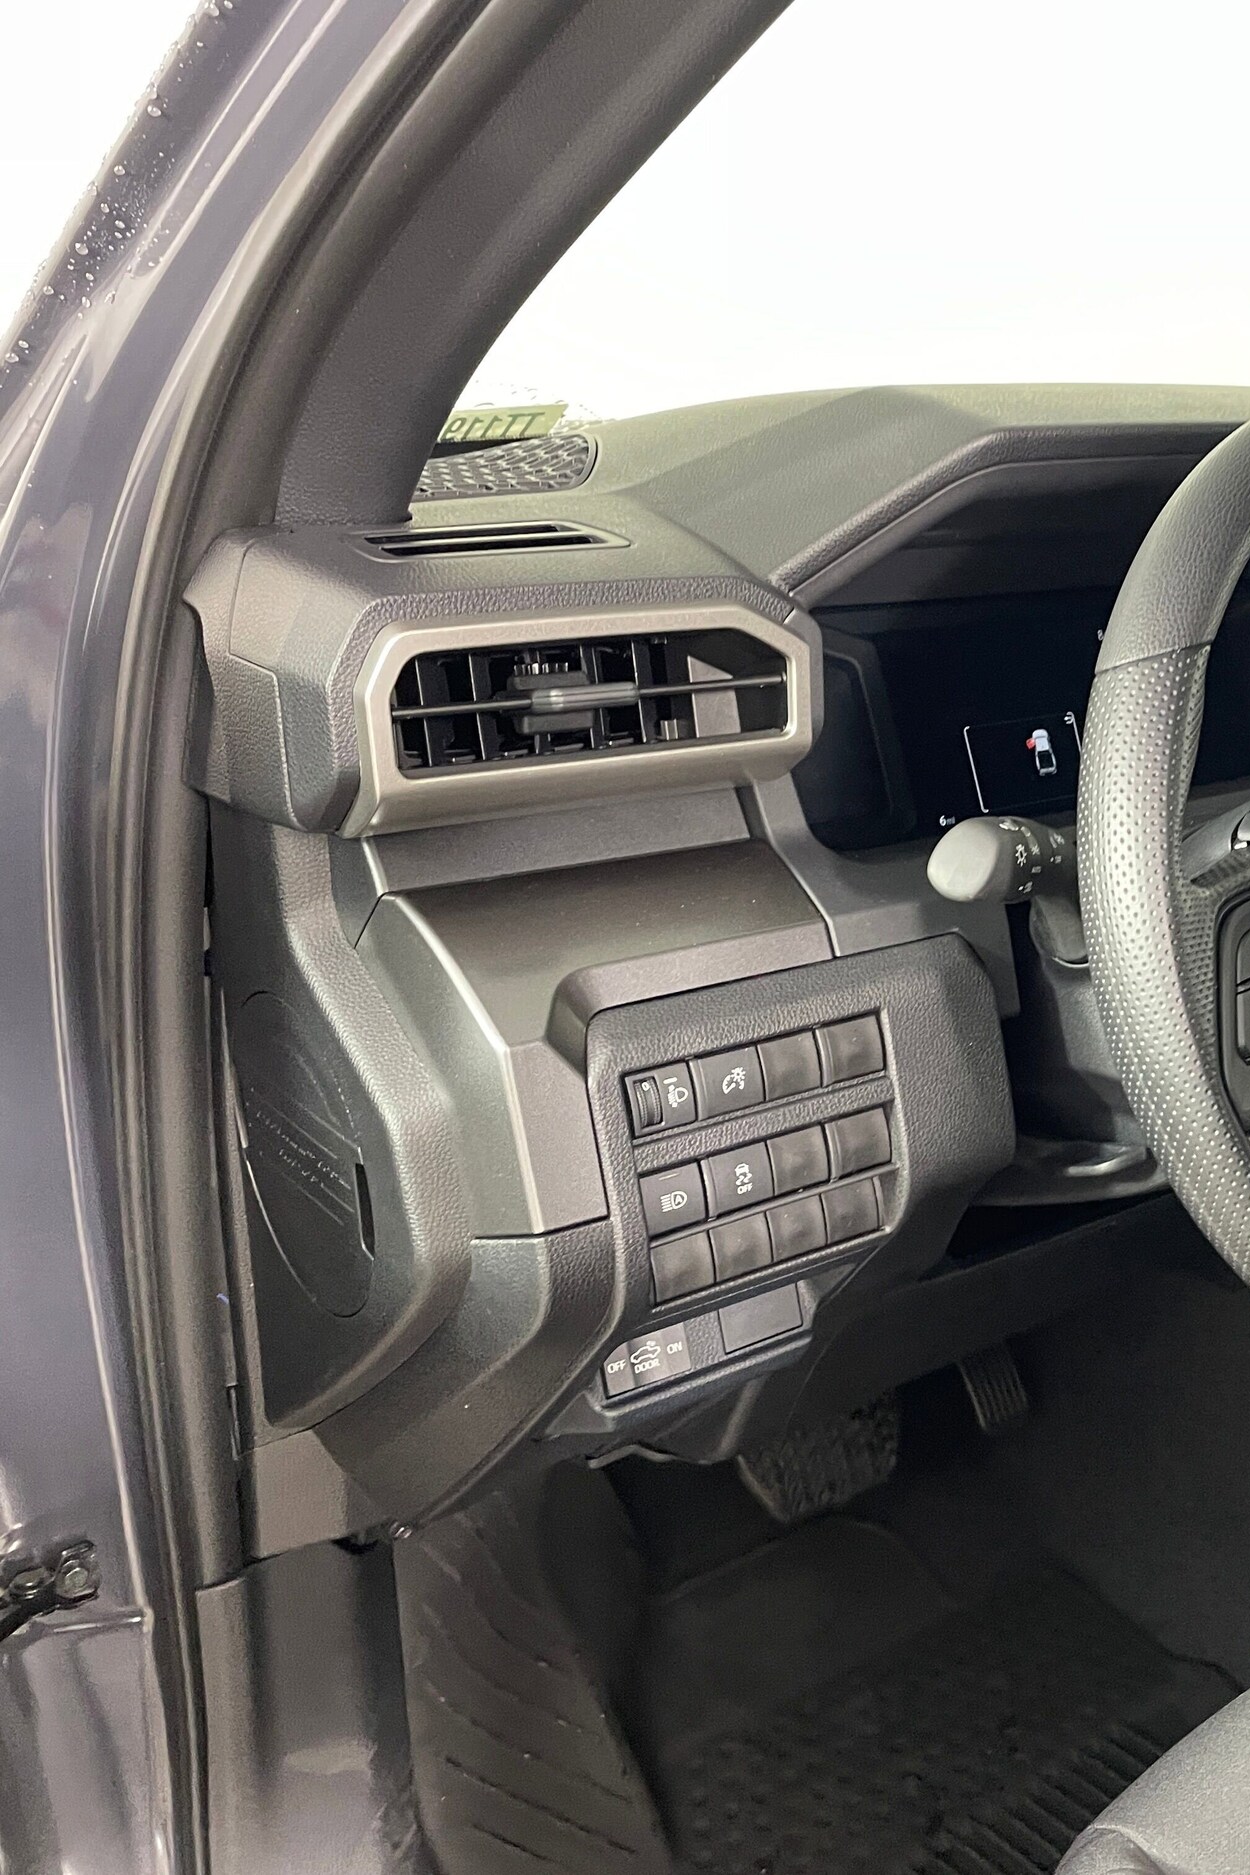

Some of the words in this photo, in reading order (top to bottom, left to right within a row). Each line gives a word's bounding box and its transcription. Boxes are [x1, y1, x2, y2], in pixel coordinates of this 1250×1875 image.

[736, 1183, 753, 1195] OFF
[666, 1341, 683, 1354] ON
[607, 1359, 627, 1374] OFF
[634, 1358, 661, 1374] DOOR
